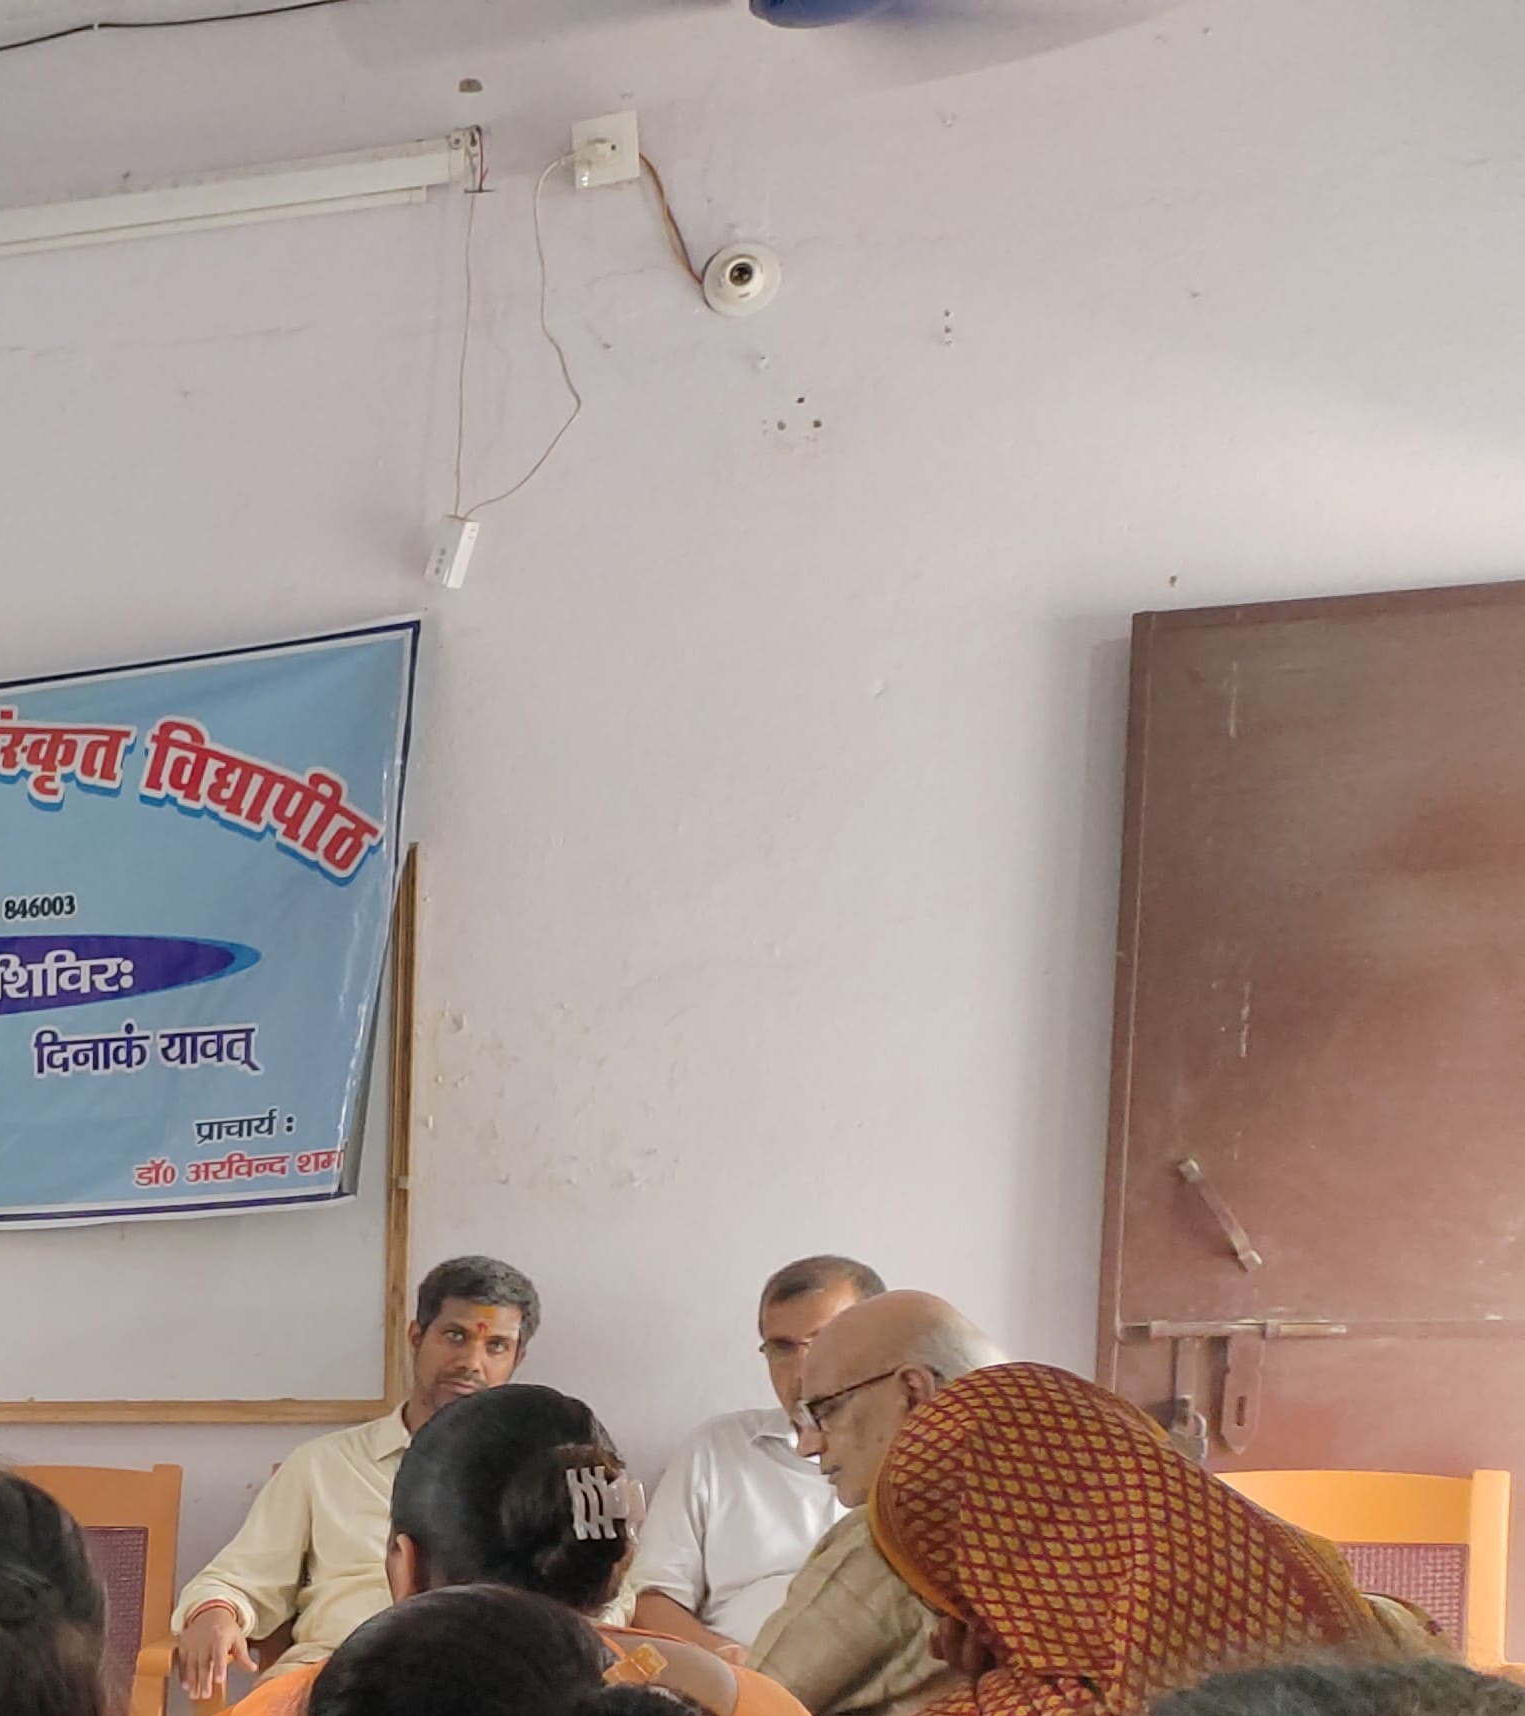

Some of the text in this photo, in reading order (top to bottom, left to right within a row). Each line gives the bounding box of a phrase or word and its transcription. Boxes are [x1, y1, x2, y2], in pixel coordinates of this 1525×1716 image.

[145, 719, 380, 875] विद्यापीठ
[4, 895, 76, 920] 846003
[159, 1028, 261, 1071] यावत्
[196, 1109, 277, 1144] प्राचार्य
[186, 1153, 289, 1182] अरविन्द
